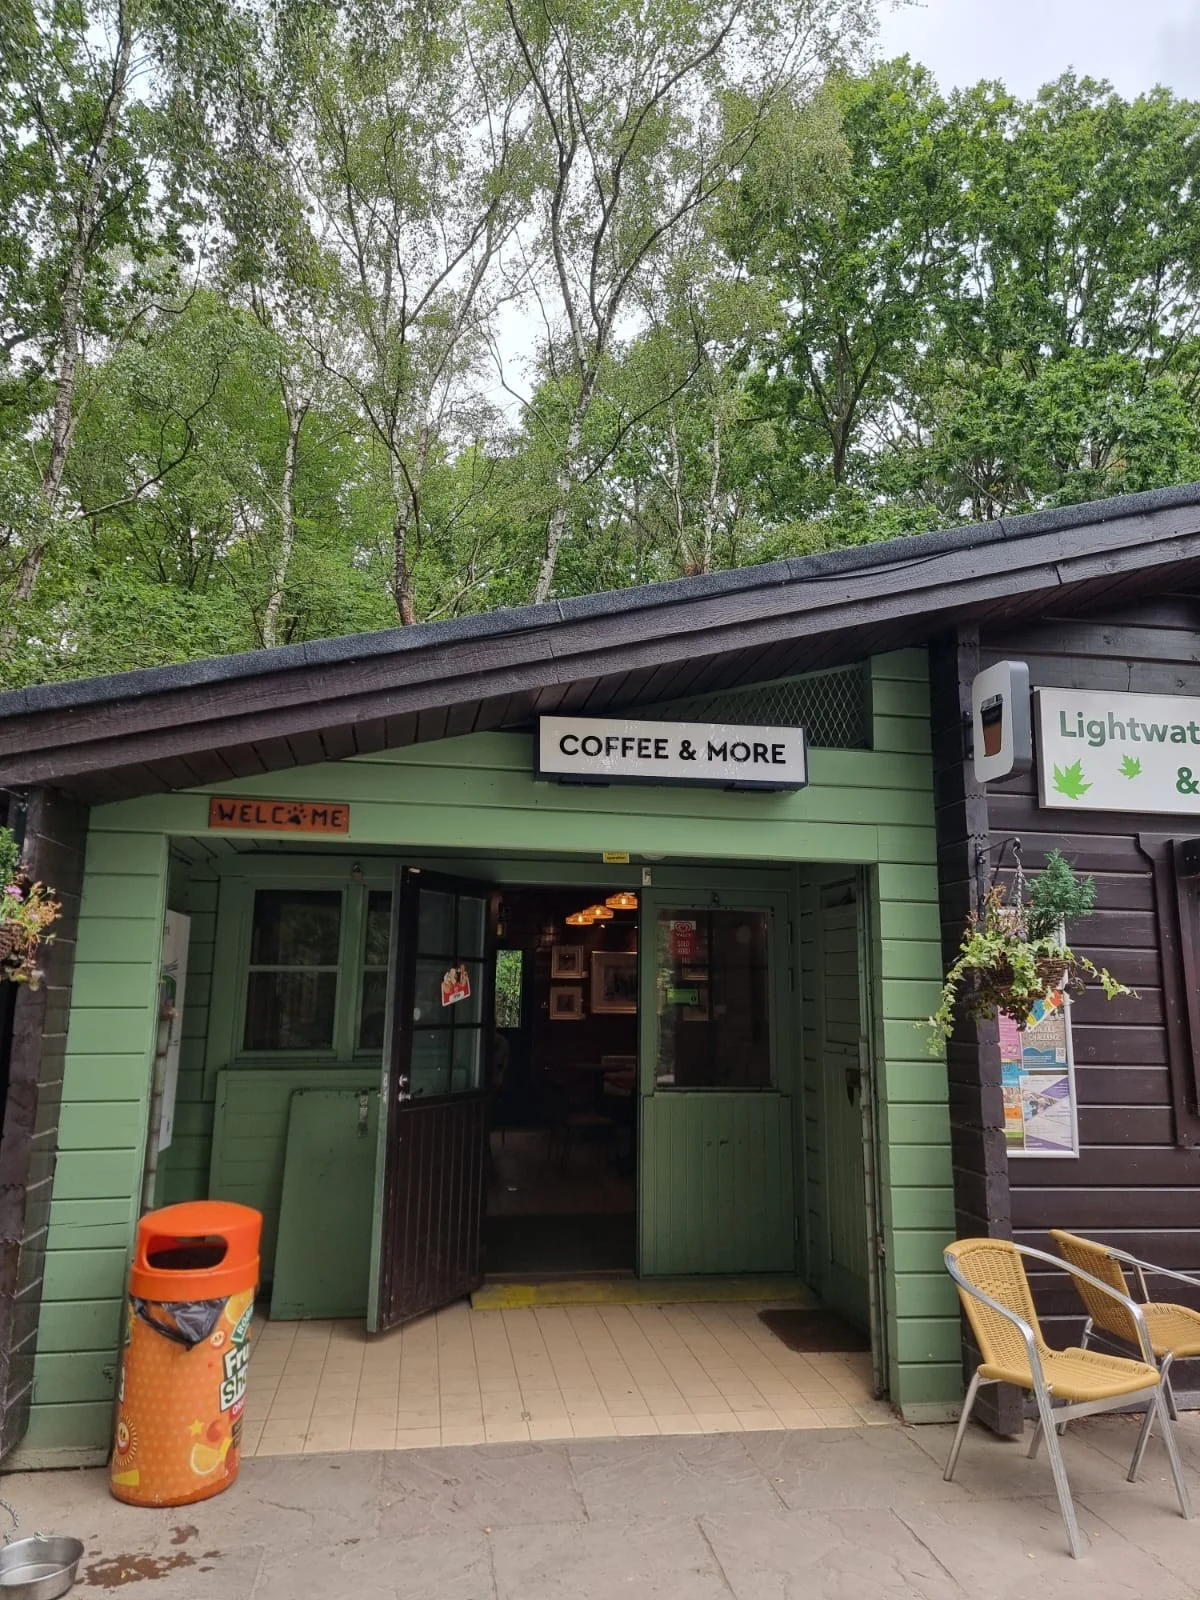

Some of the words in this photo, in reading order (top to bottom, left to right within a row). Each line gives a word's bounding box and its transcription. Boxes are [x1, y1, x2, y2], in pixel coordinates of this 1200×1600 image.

[1059, 710, 1200, 747] Lightwat
[559, 734, 669, 759] COFFEE
[678, 739, 697, 761] &
[707, 740, 786, 765] MORE
[1175, 766, 1200, 795] &
[217, 803, 343, 827] WELCME
